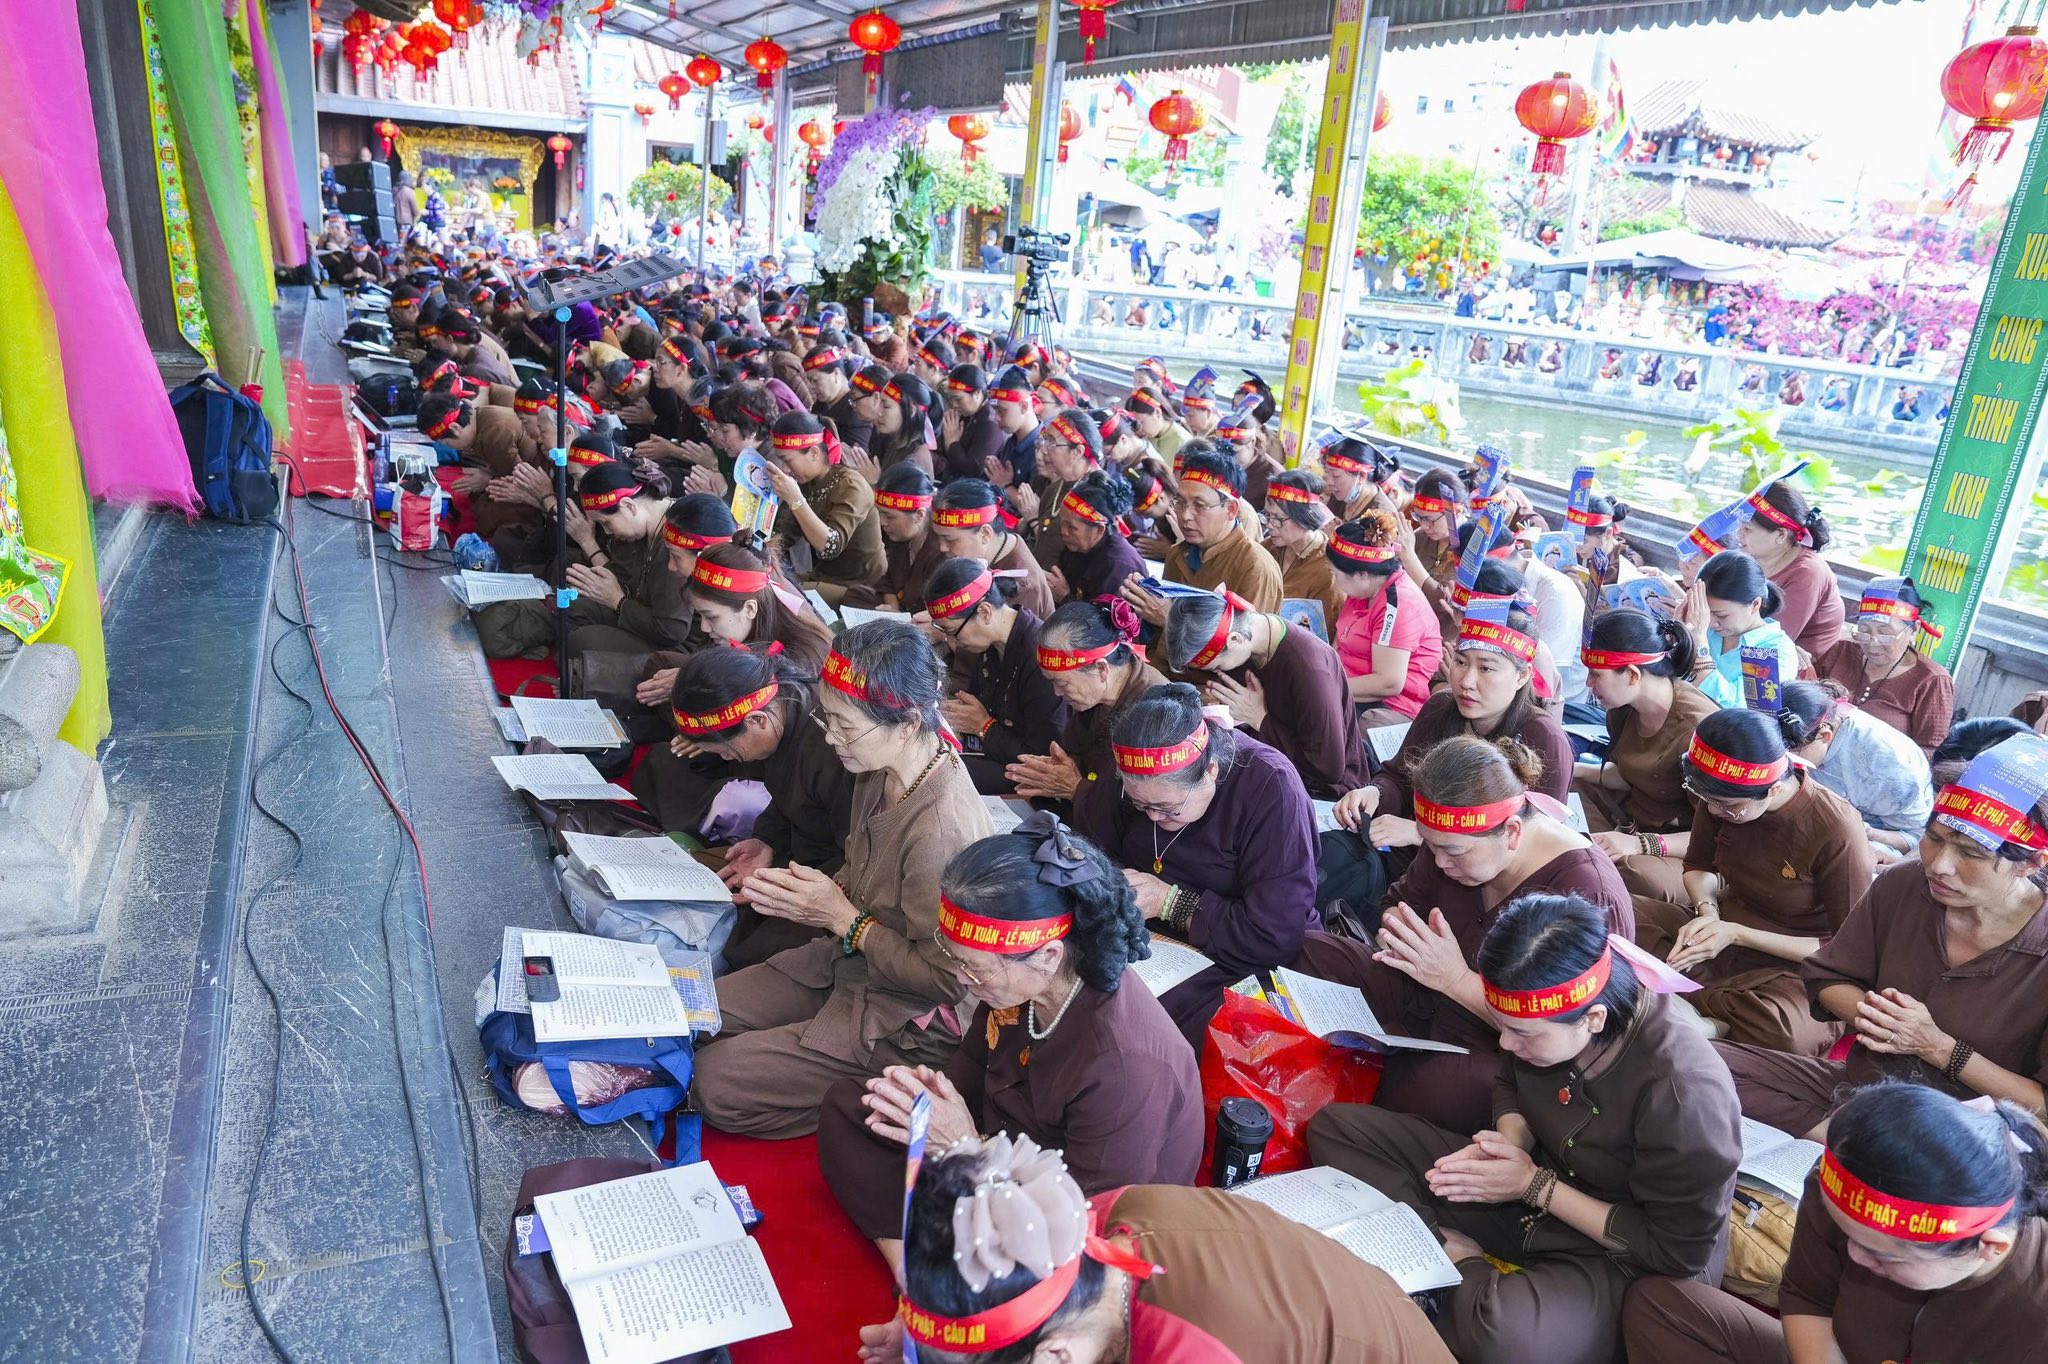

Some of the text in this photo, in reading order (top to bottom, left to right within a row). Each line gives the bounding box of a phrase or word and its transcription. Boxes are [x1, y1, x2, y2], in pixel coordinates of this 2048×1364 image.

[1989, 314, 2043, 365] CUNG
[1963, 381, 2020, 445] THỈNH
[1942, 471, 1990, 520] KINH
[1919, 534, 1971, 595] THỈNH
[1437, 812, 1455, 830] PHẬT
[1476, 813, 1487, 827] AN
[1949, 792, 1969, 811] XUÂN
[1971, 799, 1988, 818] LỄ
[1983, 805, 2010, 829] PHẬT
[959, 921, 974, 939] DU
[973, 924, 1000, 945] XUÂN
[1005, 925, 1019, 946] LỄ
[1016, 928, 1042, 948] PHẬT
[1498, 991, 1520, 1012] XUÂN
[1528, 994, 1538, 1013] LỄ
[1540, 994, 1564, 1012] PHẬT
[1849, 1188, 1863, 1214] LỄ
[1864, 1200, 1899, 1228] PHẬT
[968, 1323, 985, 1345] AN
